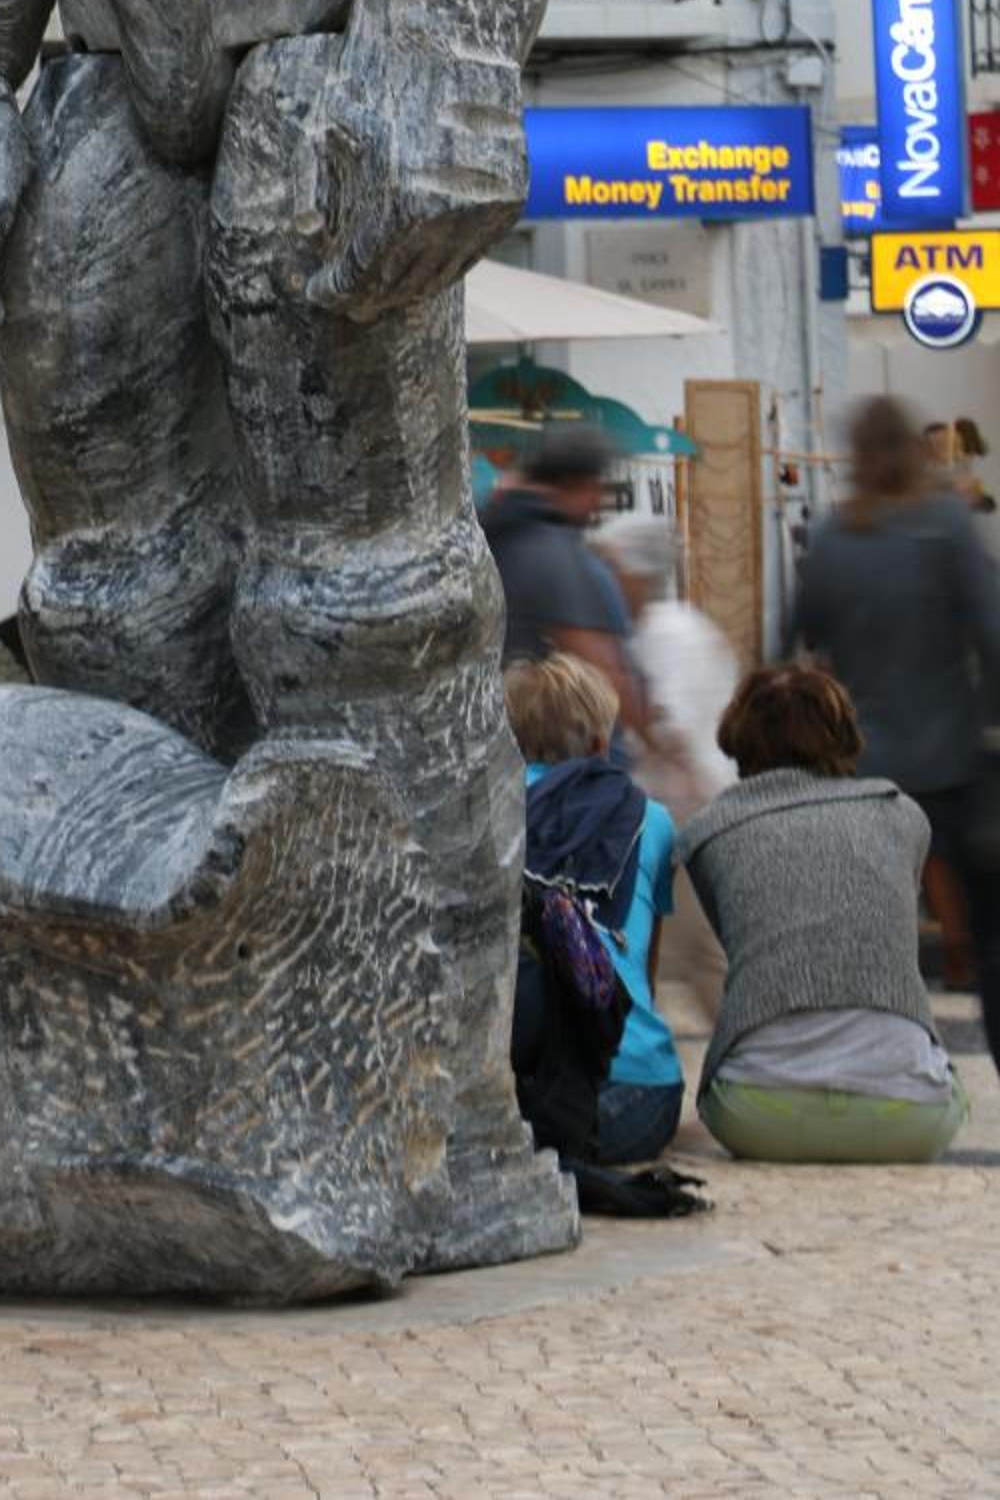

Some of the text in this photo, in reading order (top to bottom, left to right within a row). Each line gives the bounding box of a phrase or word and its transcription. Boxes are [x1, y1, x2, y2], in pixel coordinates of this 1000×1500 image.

[647, 140, 790, 175] Exchange
[565, 173, 790, 209] Money Transfer
[894, 244, 983, 270] ATM
